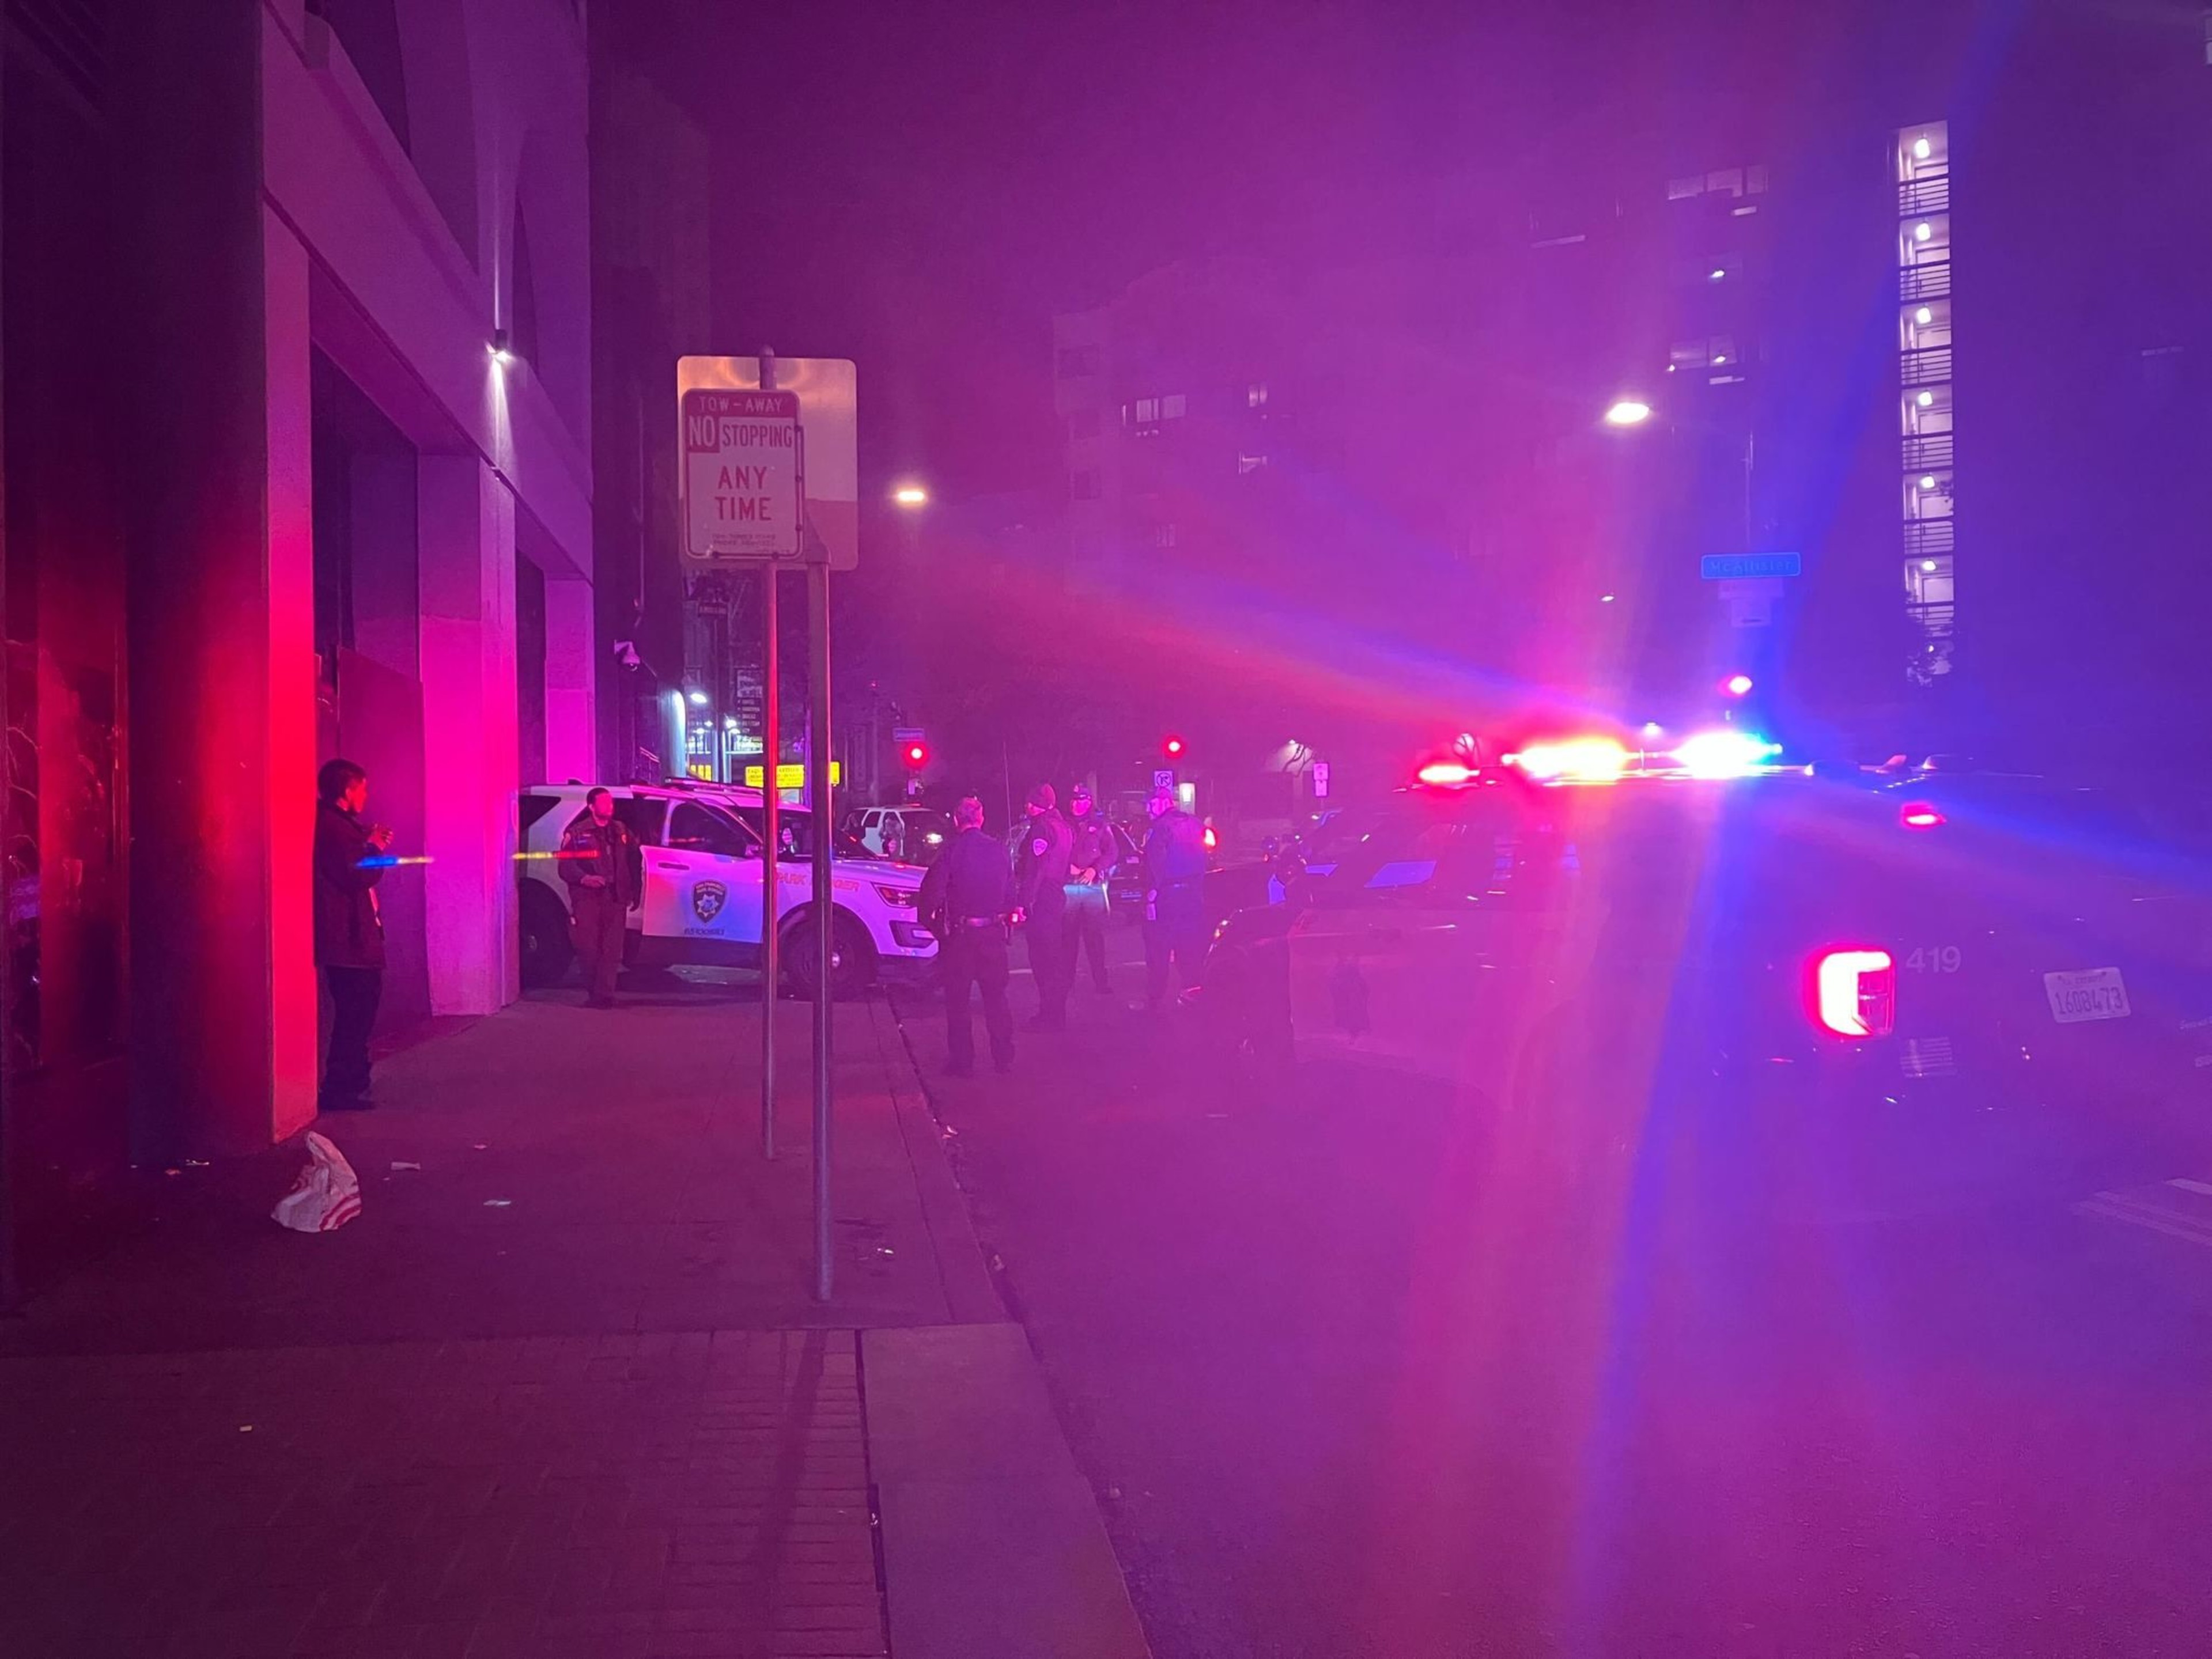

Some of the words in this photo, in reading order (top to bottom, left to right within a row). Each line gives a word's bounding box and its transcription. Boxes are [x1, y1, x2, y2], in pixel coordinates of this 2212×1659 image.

[689, 415, 716, 447] NO
[722, 425, 793, 448] STOPPING
[718, 465, 767, 490] ANY
[714, 497, 772, 521] TIME
[1905, 946, 1961, 974] 419
[2055, 986, 2123, 1015] 1608473
